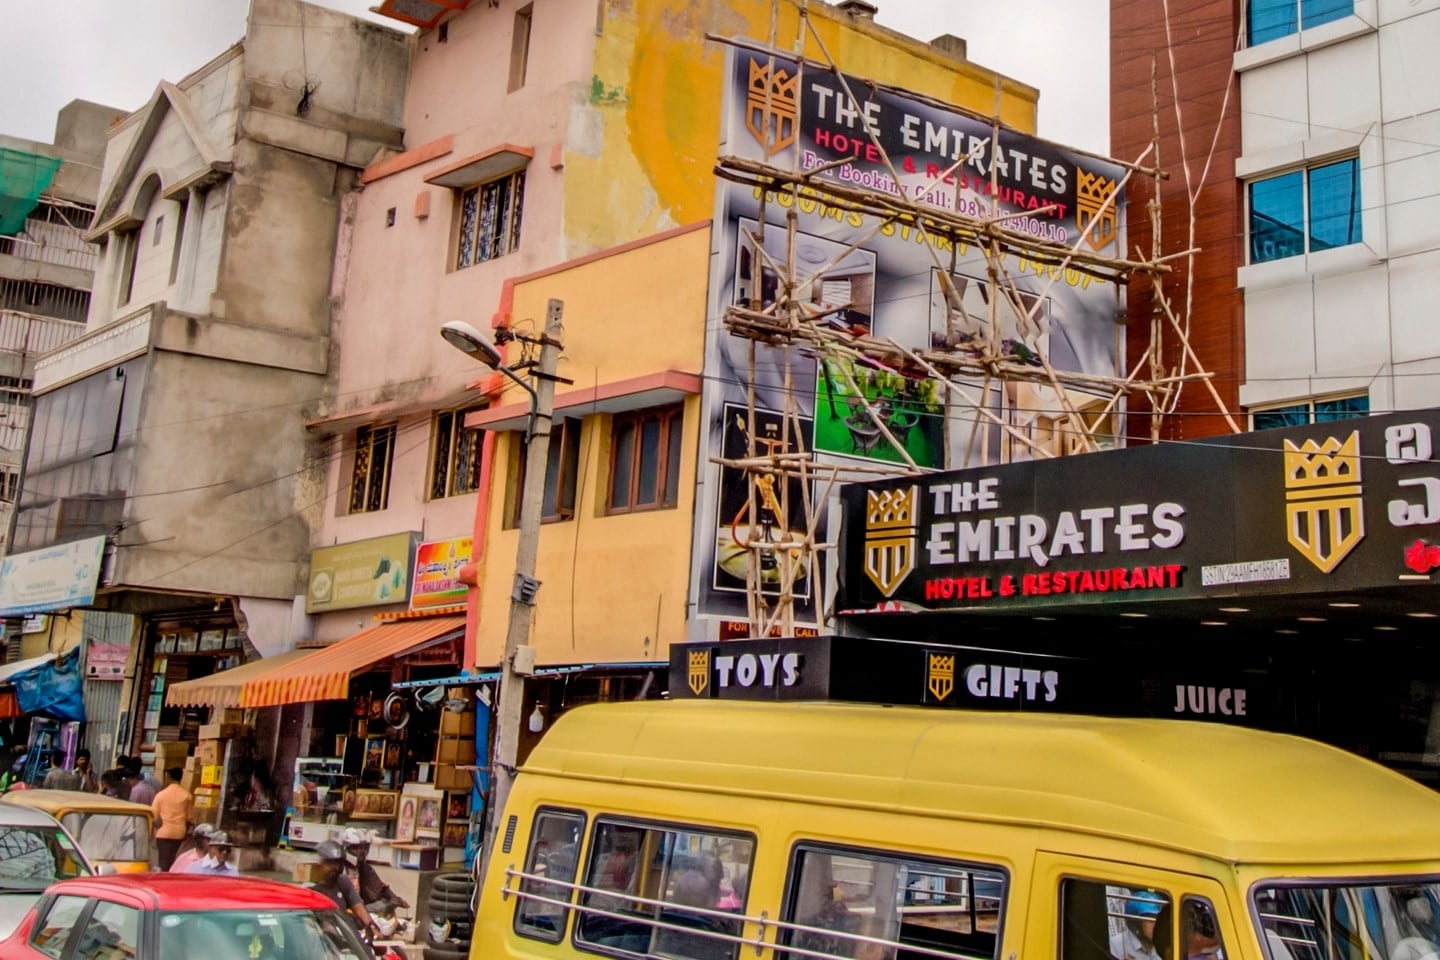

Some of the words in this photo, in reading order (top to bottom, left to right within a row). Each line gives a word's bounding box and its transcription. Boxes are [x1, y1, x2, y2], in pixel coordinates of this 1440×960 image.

[812, 84, 882, 137] THE
[901, 114, 1067, 195] EMIRATES
[903, 156, 917, 174] &
[926, 163, 1066, 220] RESTAURANT
[929, 478, 999, 515] THE
[926, 502, 1186, 567] EMIRATES
[925, 577, 992, 600] HOTEL
[1000, 574, 1016, 596] &
[1022, 564, 1183, 596] RESTAURANT
[728, 622, 748, 632] FOR
[715, 653, 799, 687] TOYS
[965, 664, 1059, 702] GIFTS
[1174, 684, 1247, 716] JUICE
